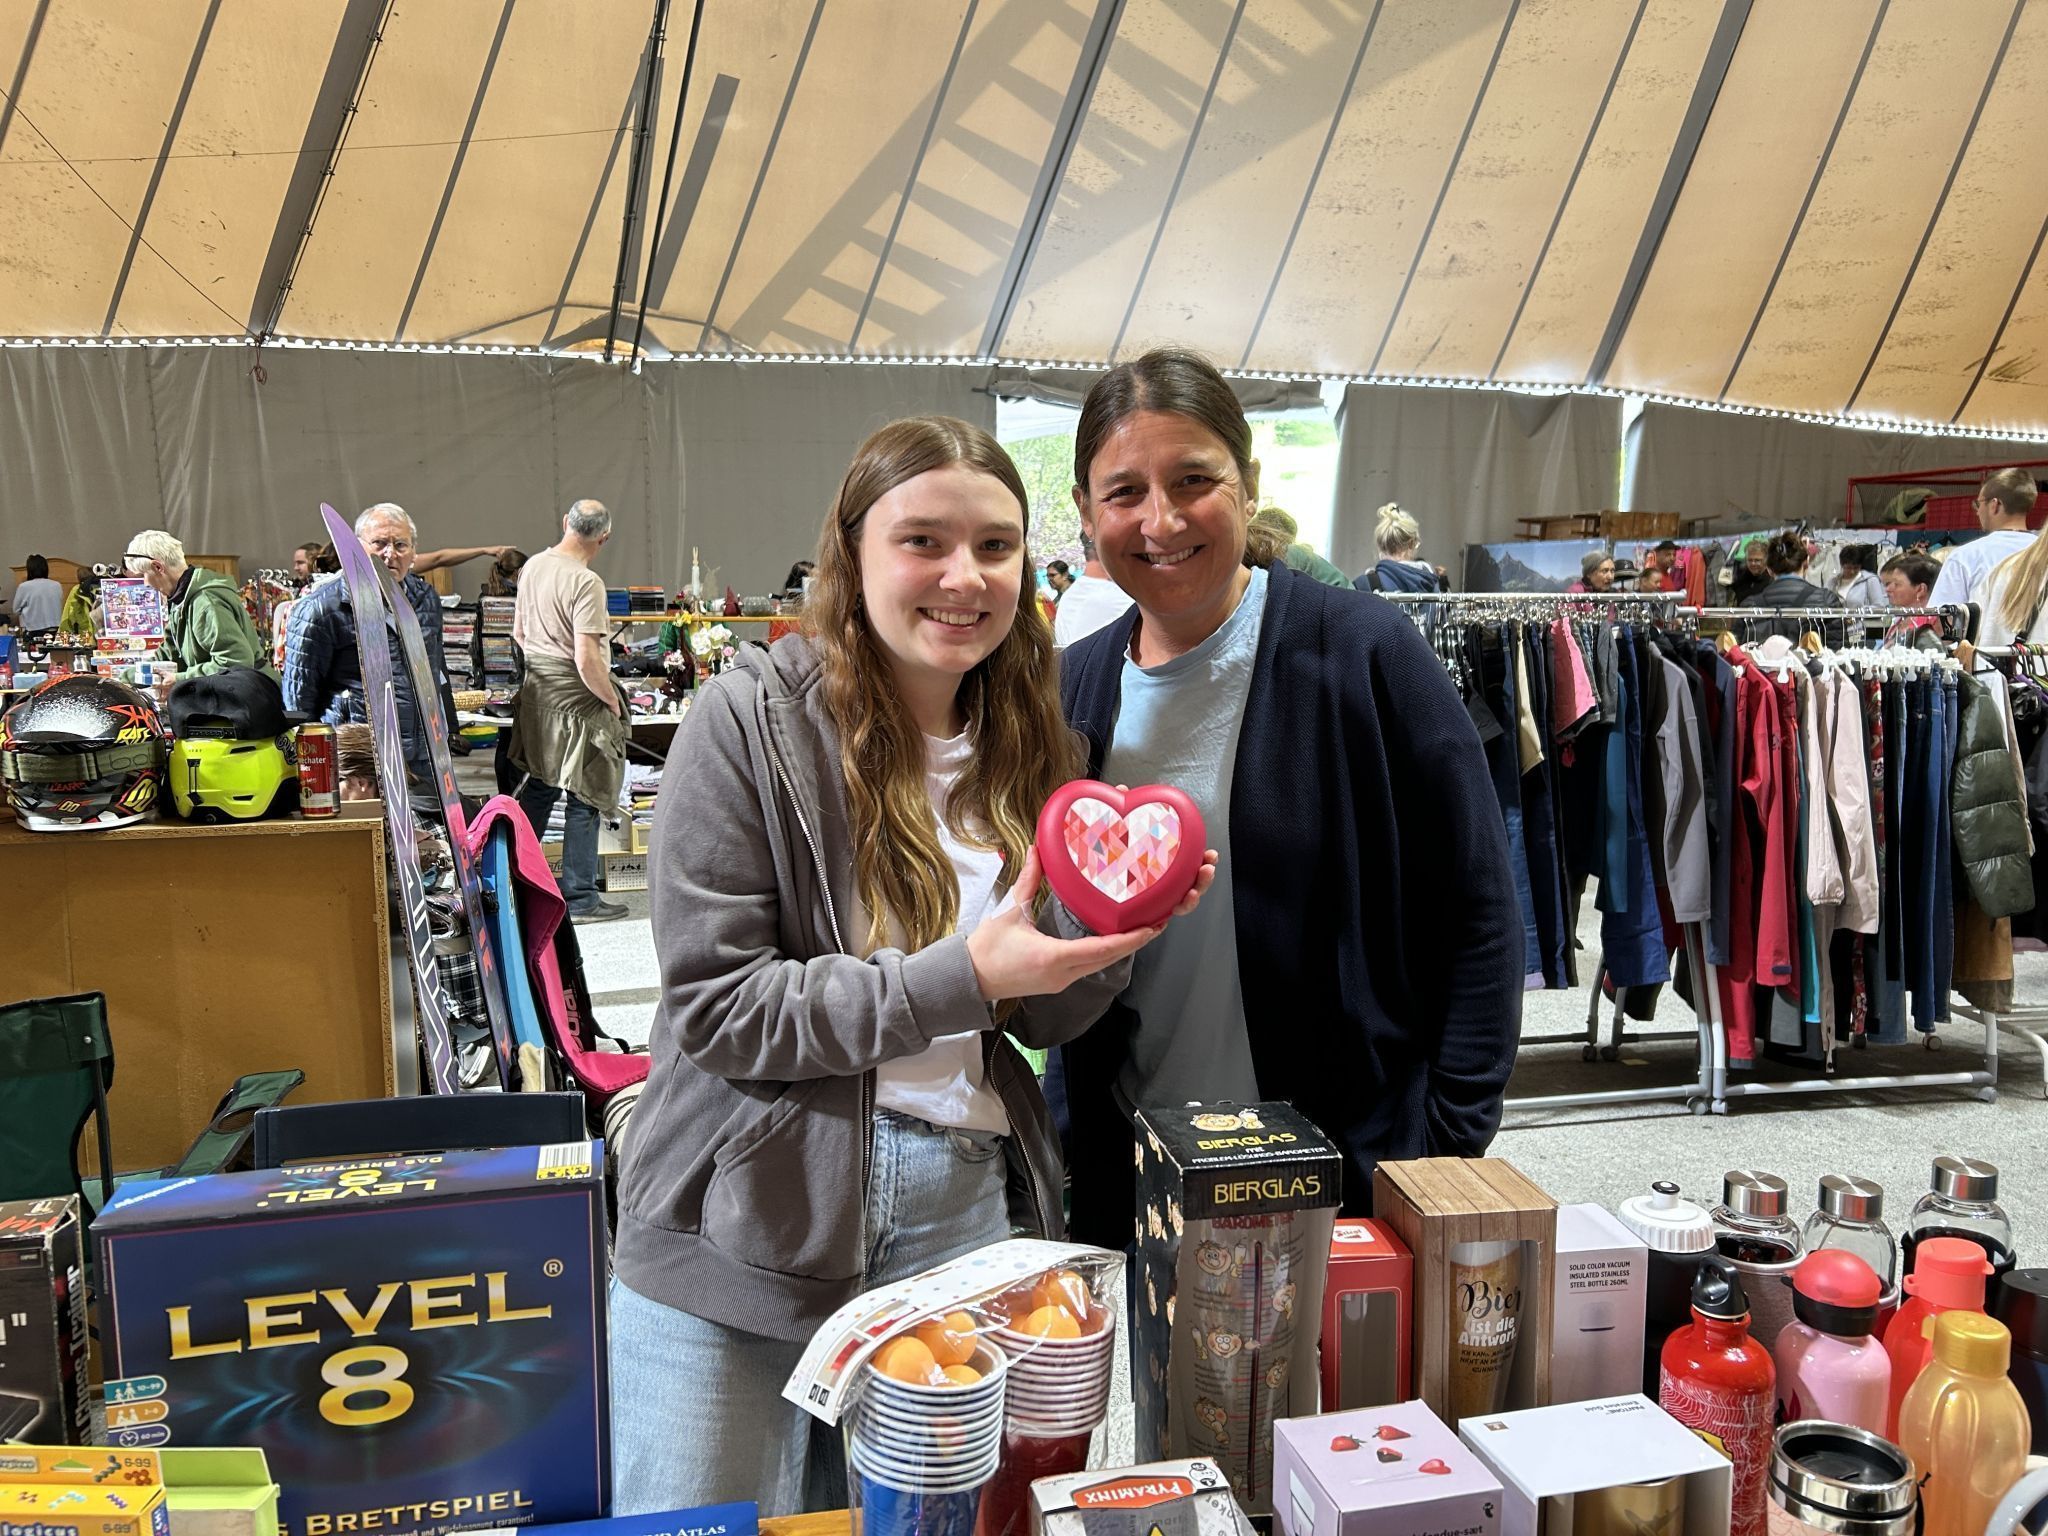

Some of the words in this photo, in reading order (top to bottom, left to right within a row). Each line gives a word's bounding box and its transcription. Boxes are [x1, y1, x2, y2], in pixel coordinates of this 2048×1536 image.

[1197, 1133, 1297, 1150] BIERGLAS
[282, 1161, 397, 1175] BRETTSPIEL
[338, 1169, 382, 1187] 8
[268, 1179, 437, 1203] LEVEL
[1214, 1175, 1321, 1204] BIERGLAS
[1212, 1213, 1295, 1229] BAROMETER
[1569, 1272, 1599, 1280] INSULATED
[1600, 1270, 1630, 1278] STAINLESS
[1458, 1280, 1521, 1319] Bier
[66, 1264, 87, 1356] Trainer
[166, 1272, 552, 1361] LEVEL
[1470, 1320, 1491, 1334] ist
[1496, 1316, 1515, 1332] die
[74, 1356, 91, 1428] Chess
[319, 1345, 415, 1427] 8
[124, 1458, 151, 1468] 6-99
[1084, 1481, 1184, 1504] PYRAMINX
[306, 1490, 533, 1536] BRETTSPIEL
[496, 1513, 535, 1527] garantiert!
[103, 1524, 131, 1534] 6-99
[676, 1524, 727, 1536] ATLAS
